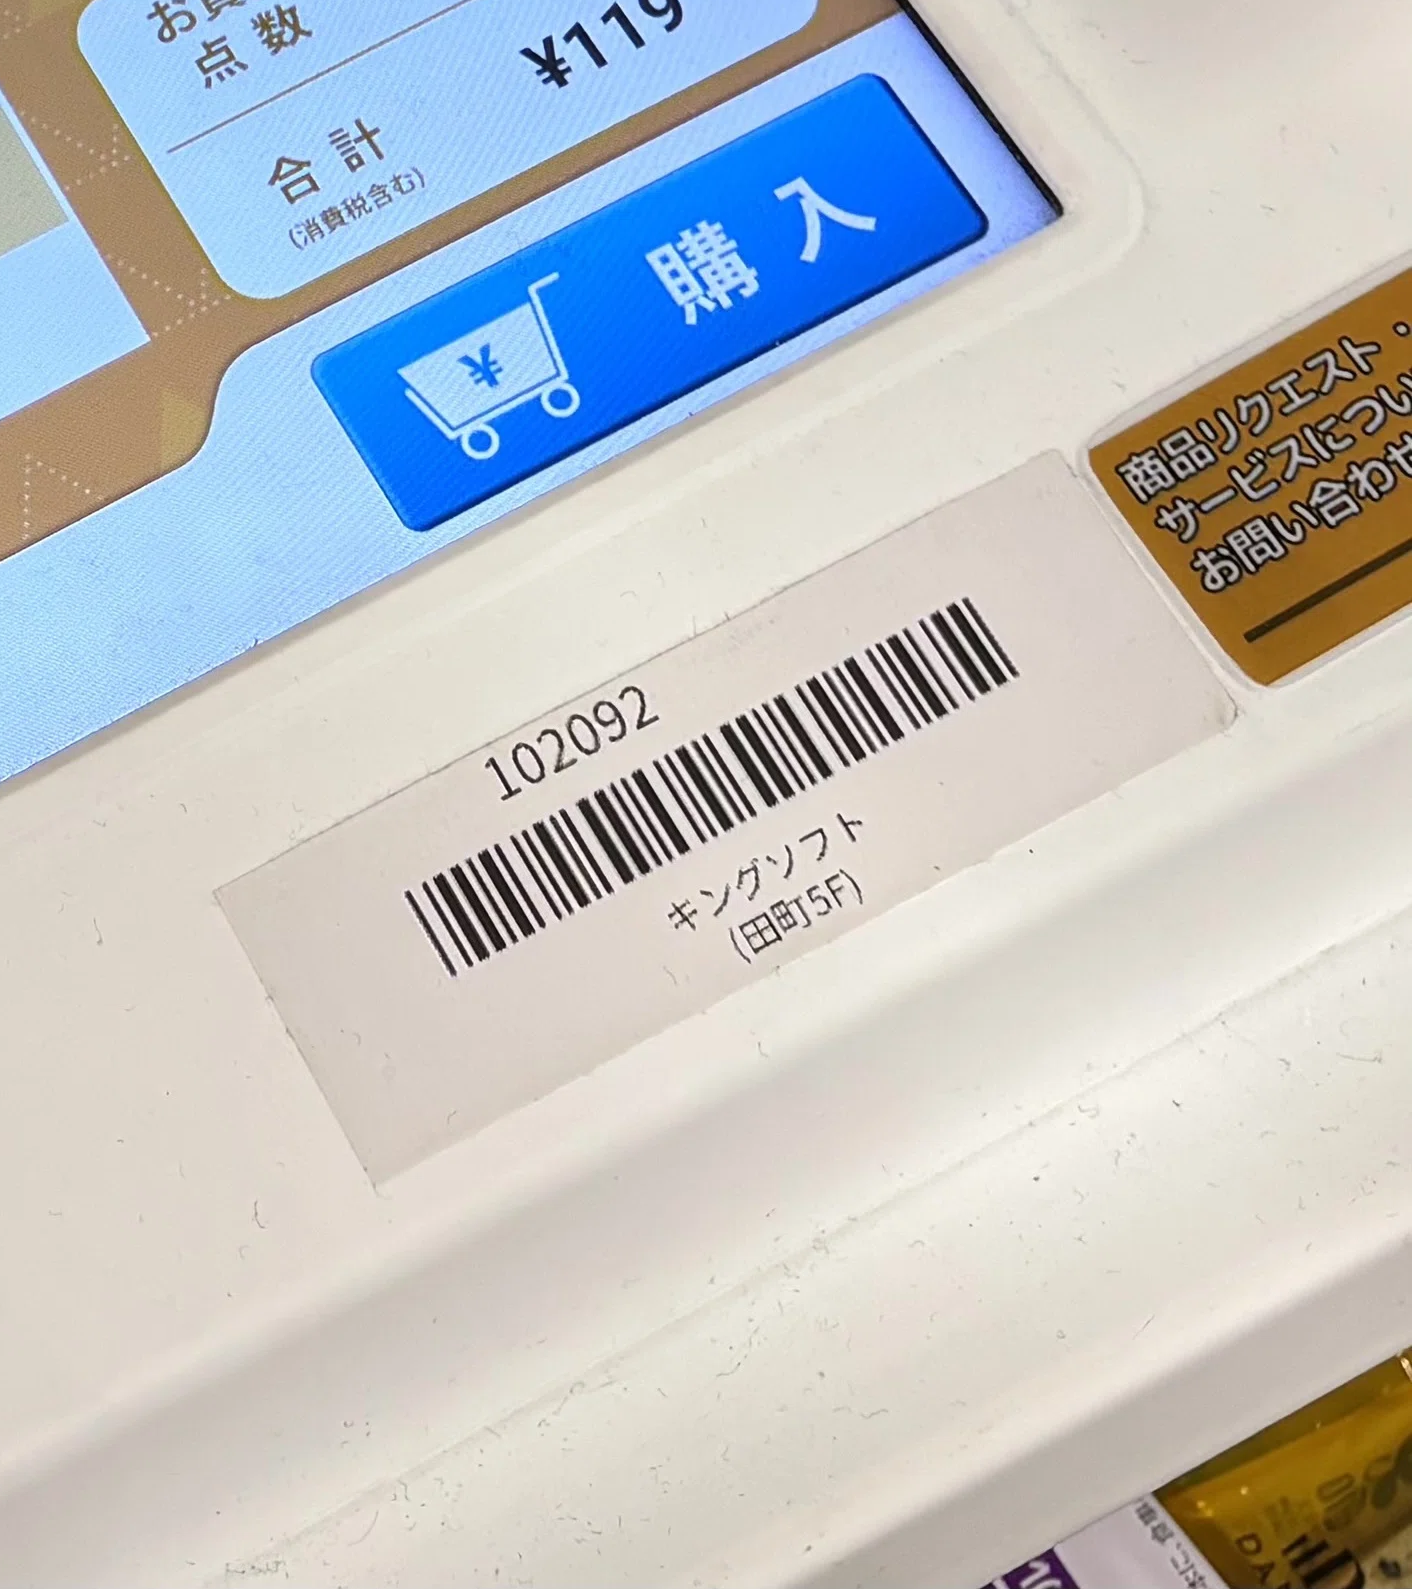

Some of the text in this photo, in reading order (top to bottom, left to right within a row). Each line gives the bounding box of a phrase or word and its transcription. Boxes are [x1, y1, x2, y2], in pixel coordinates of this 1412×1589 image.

[195, 3, 312, 90] 点数
[267, 118, 386, 206] 合計
[288, 166, 425, 251] (消費税含む)
[644, 176, 877, 325] 購入
[482, 685, 661, 803] 102092
[667, 811, 865, 933] キングソフト
[728, 868, 865, 965] (田町5F)
